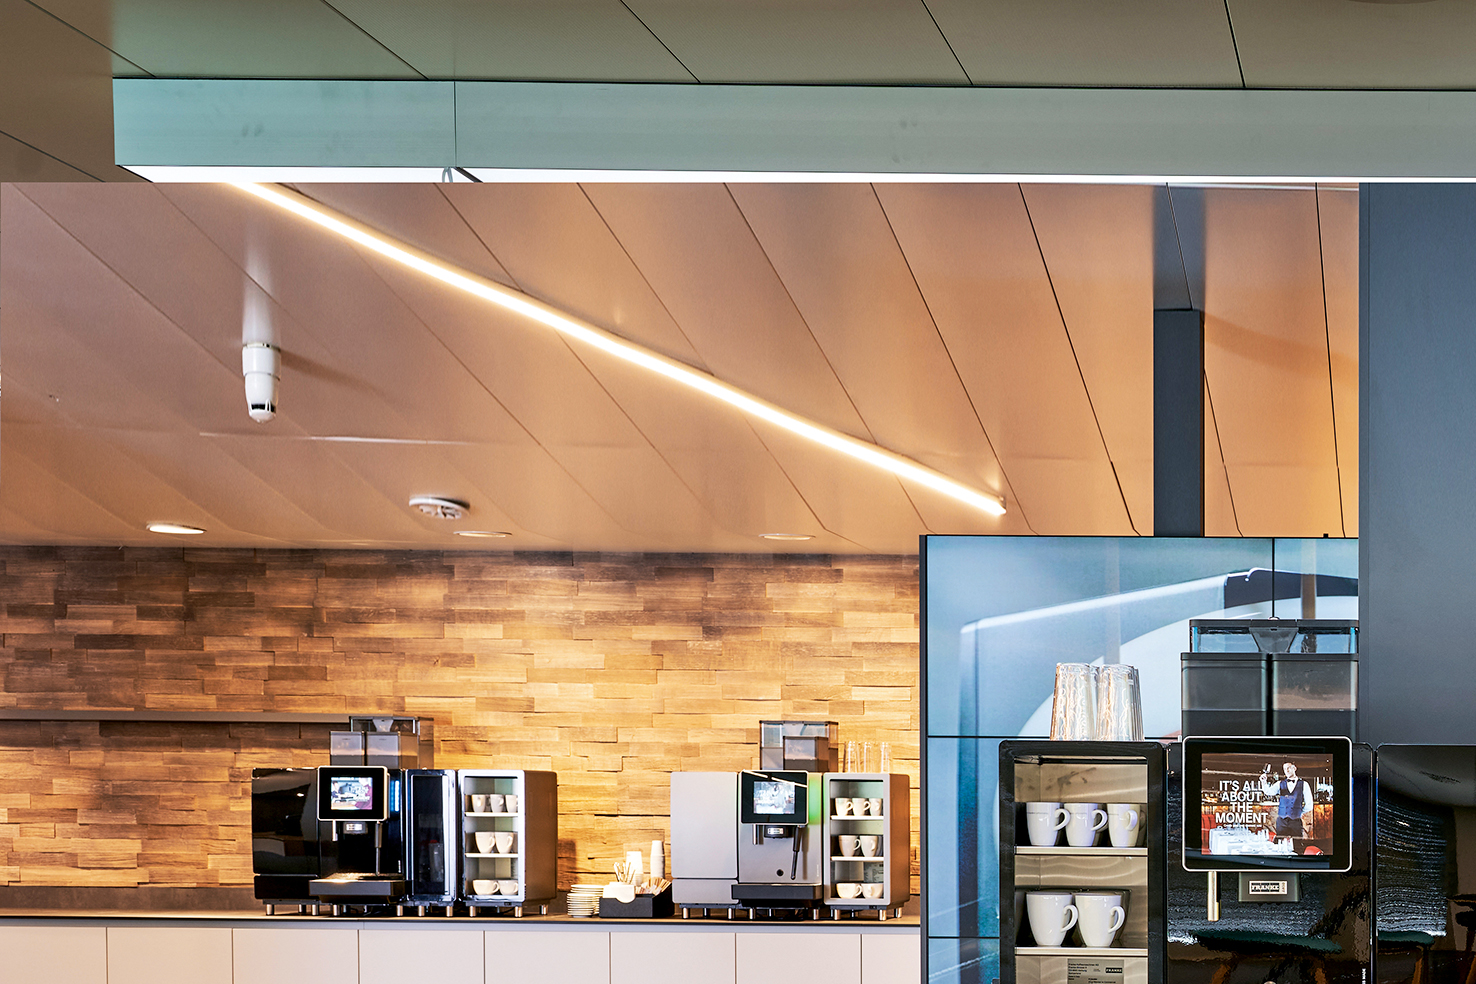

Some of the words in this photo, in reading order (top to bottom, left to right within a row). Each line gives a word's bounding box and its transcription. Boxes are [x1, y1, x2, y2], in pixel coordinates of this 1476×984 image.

[1219, 780, 1240, 791] IT'S
[1243, 780, 1263, 791] ALL
[1221, 791, 1262, 802] ABOUT
[1230, 801, 1253, 813] THE
[1215, 812, 1269, 823] MOMENT
